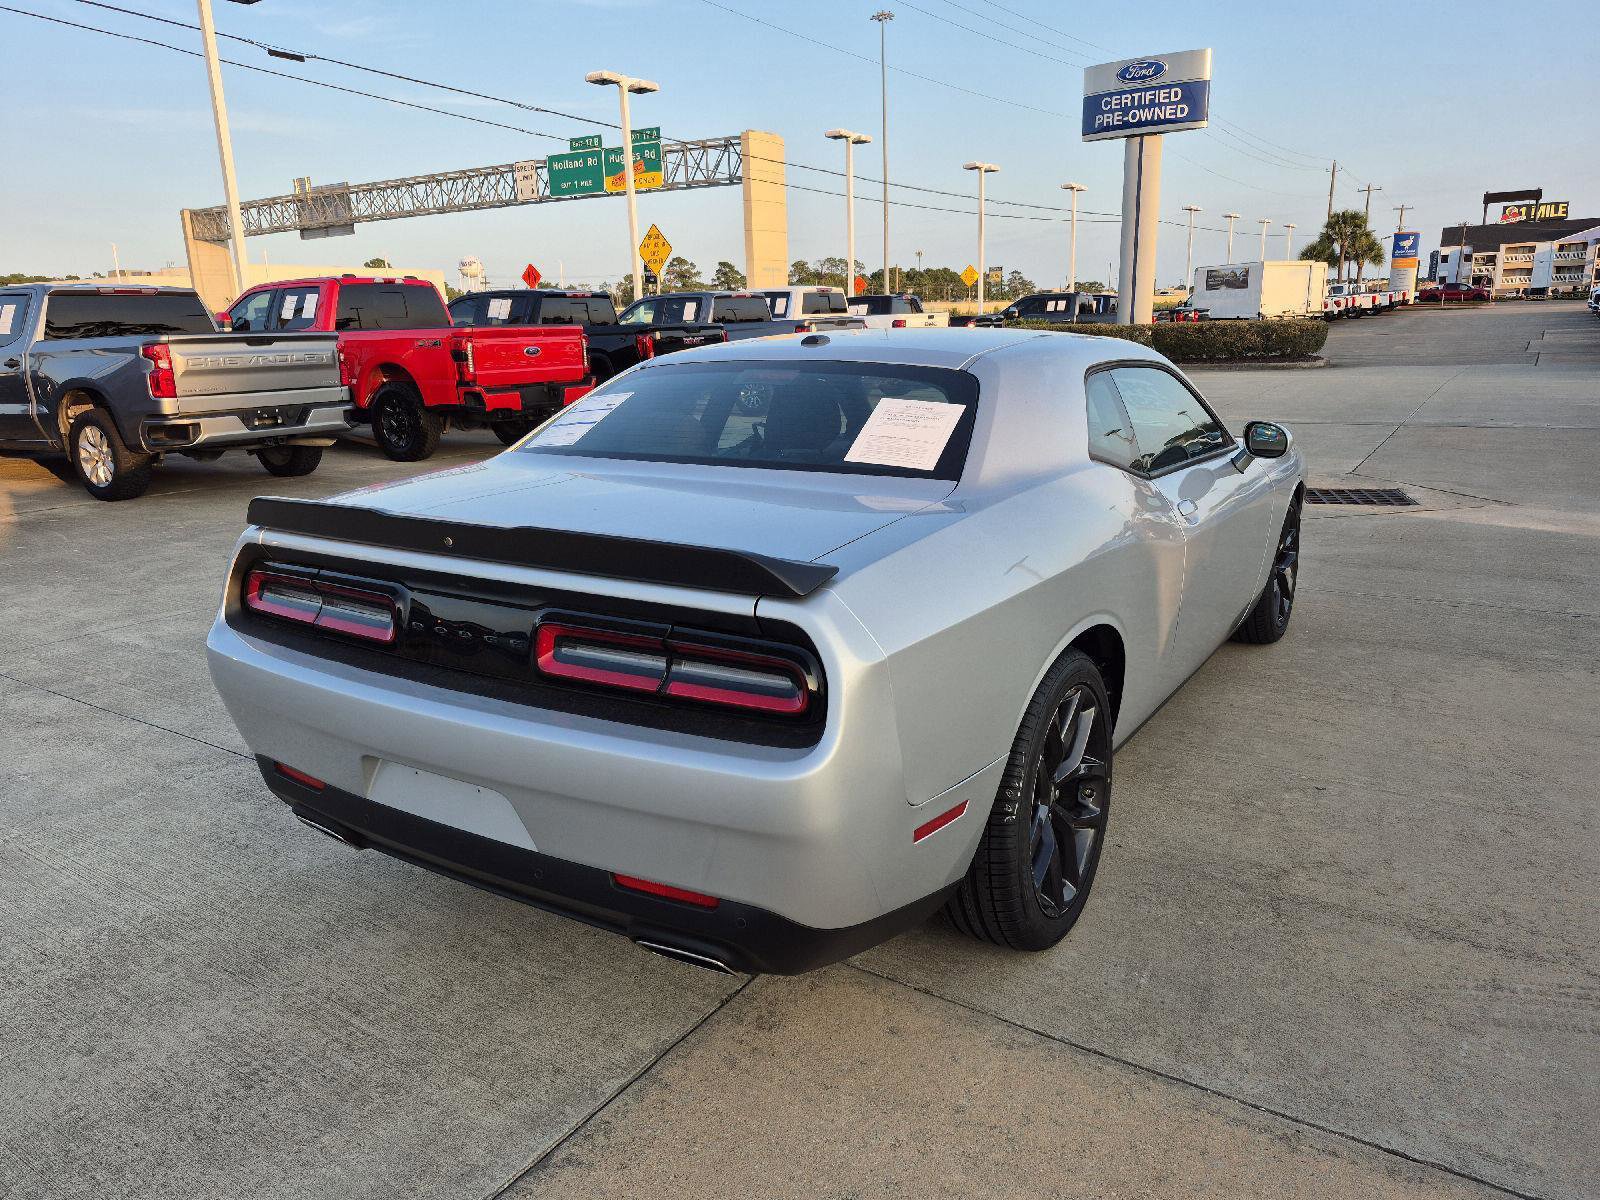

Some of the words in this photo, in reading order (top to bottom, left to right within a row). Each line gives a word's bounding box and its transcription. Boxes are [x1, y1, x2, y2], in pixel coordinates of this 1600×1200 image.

[1126, 62, 1156, 79] Ford
[1101, 87, 1182, 111] CERTIFIED
[1095, 104, 1189, 128] PRE-OWNED
[553, 158, 584, 171] Holland
[587, 156, 598, 166] Rd
[609, 152, 640, 165] Huges
[644, 149, 656, 159] Rd
[573, 180, 578, 189] 1
[1531, 204, 1568, 219] MILE
[186, 352, 331, 368] CHEVROLET
